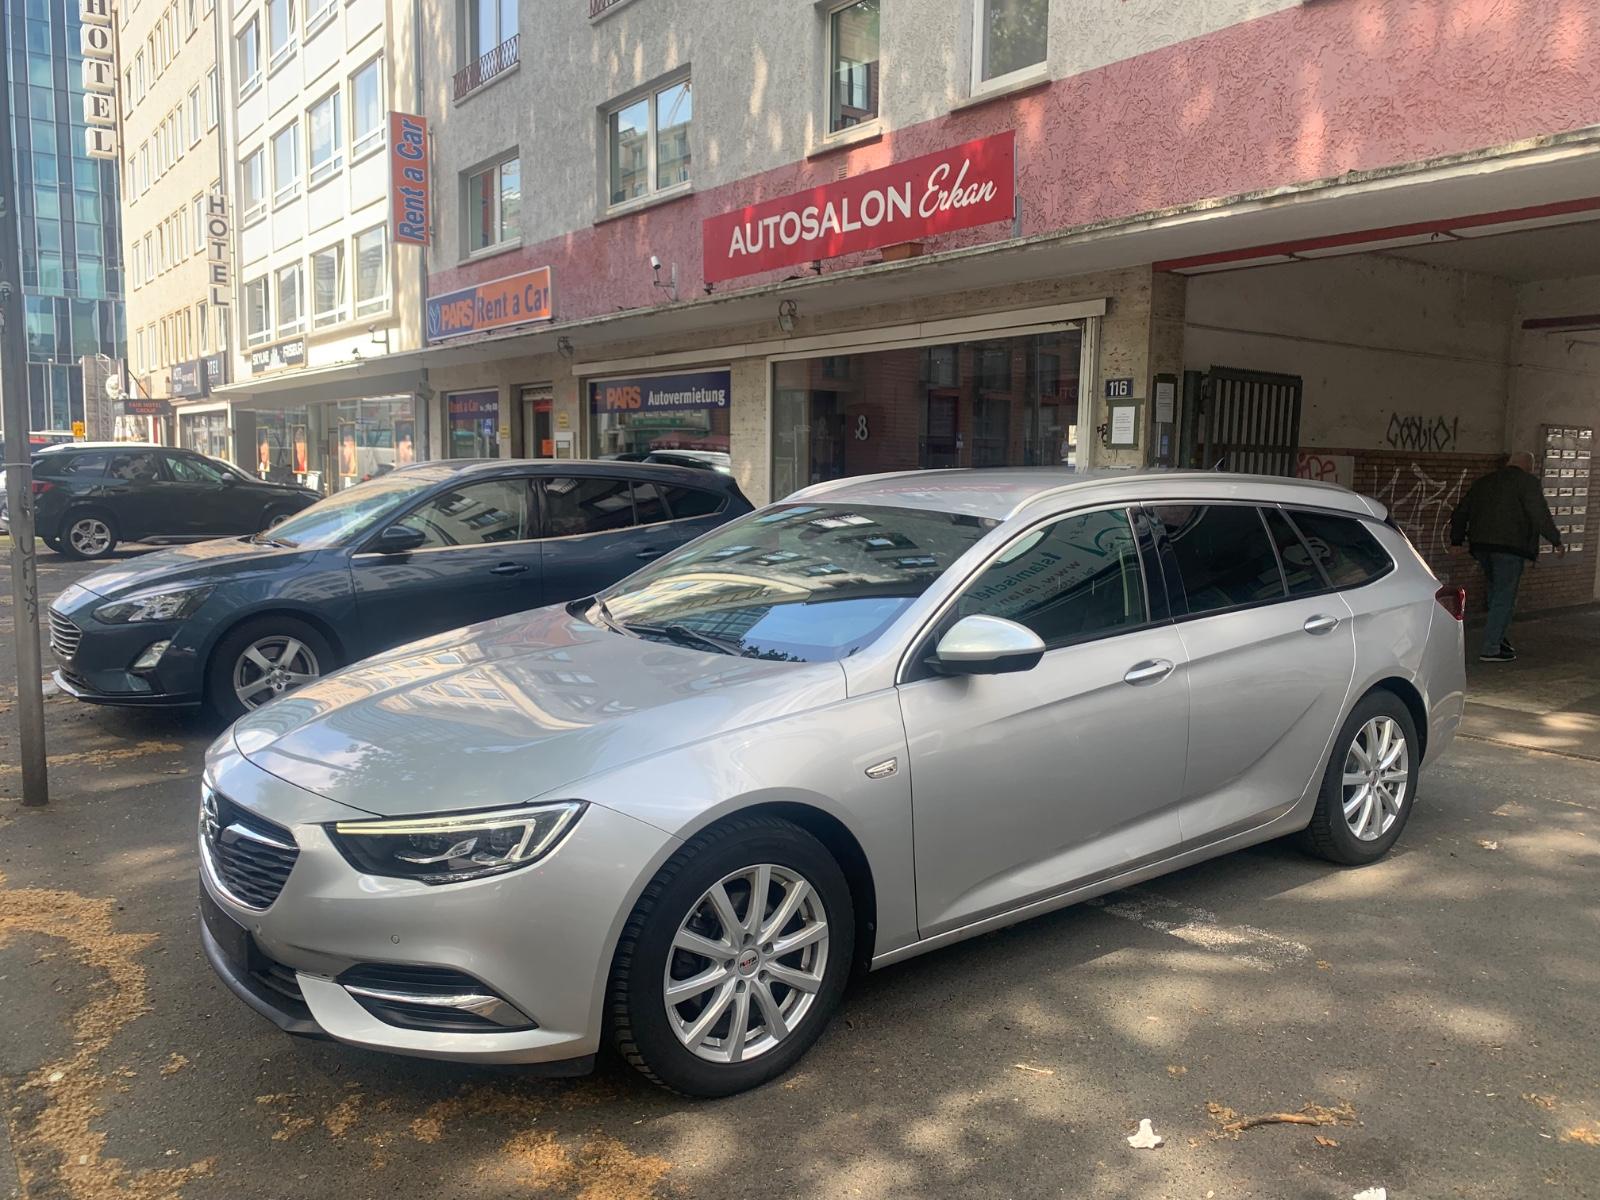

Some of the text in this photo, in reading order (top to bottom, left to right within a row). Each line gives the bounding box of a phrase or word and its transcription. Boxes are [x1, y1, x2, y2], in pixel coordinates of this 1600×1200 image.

[83, 0, 113, 152] HOTEL
[397, 119, 427, 241] Rent a Car
[727, 158, 997, 258] AUTOSALON Erkan
[208, 195, 230, 306] HOTEL
[440, 284, 550, 331] PARS Rent a Car
[606, 386, 726, 409] PARS Autovermietung
[1109, 380, 1128, 396] 116
